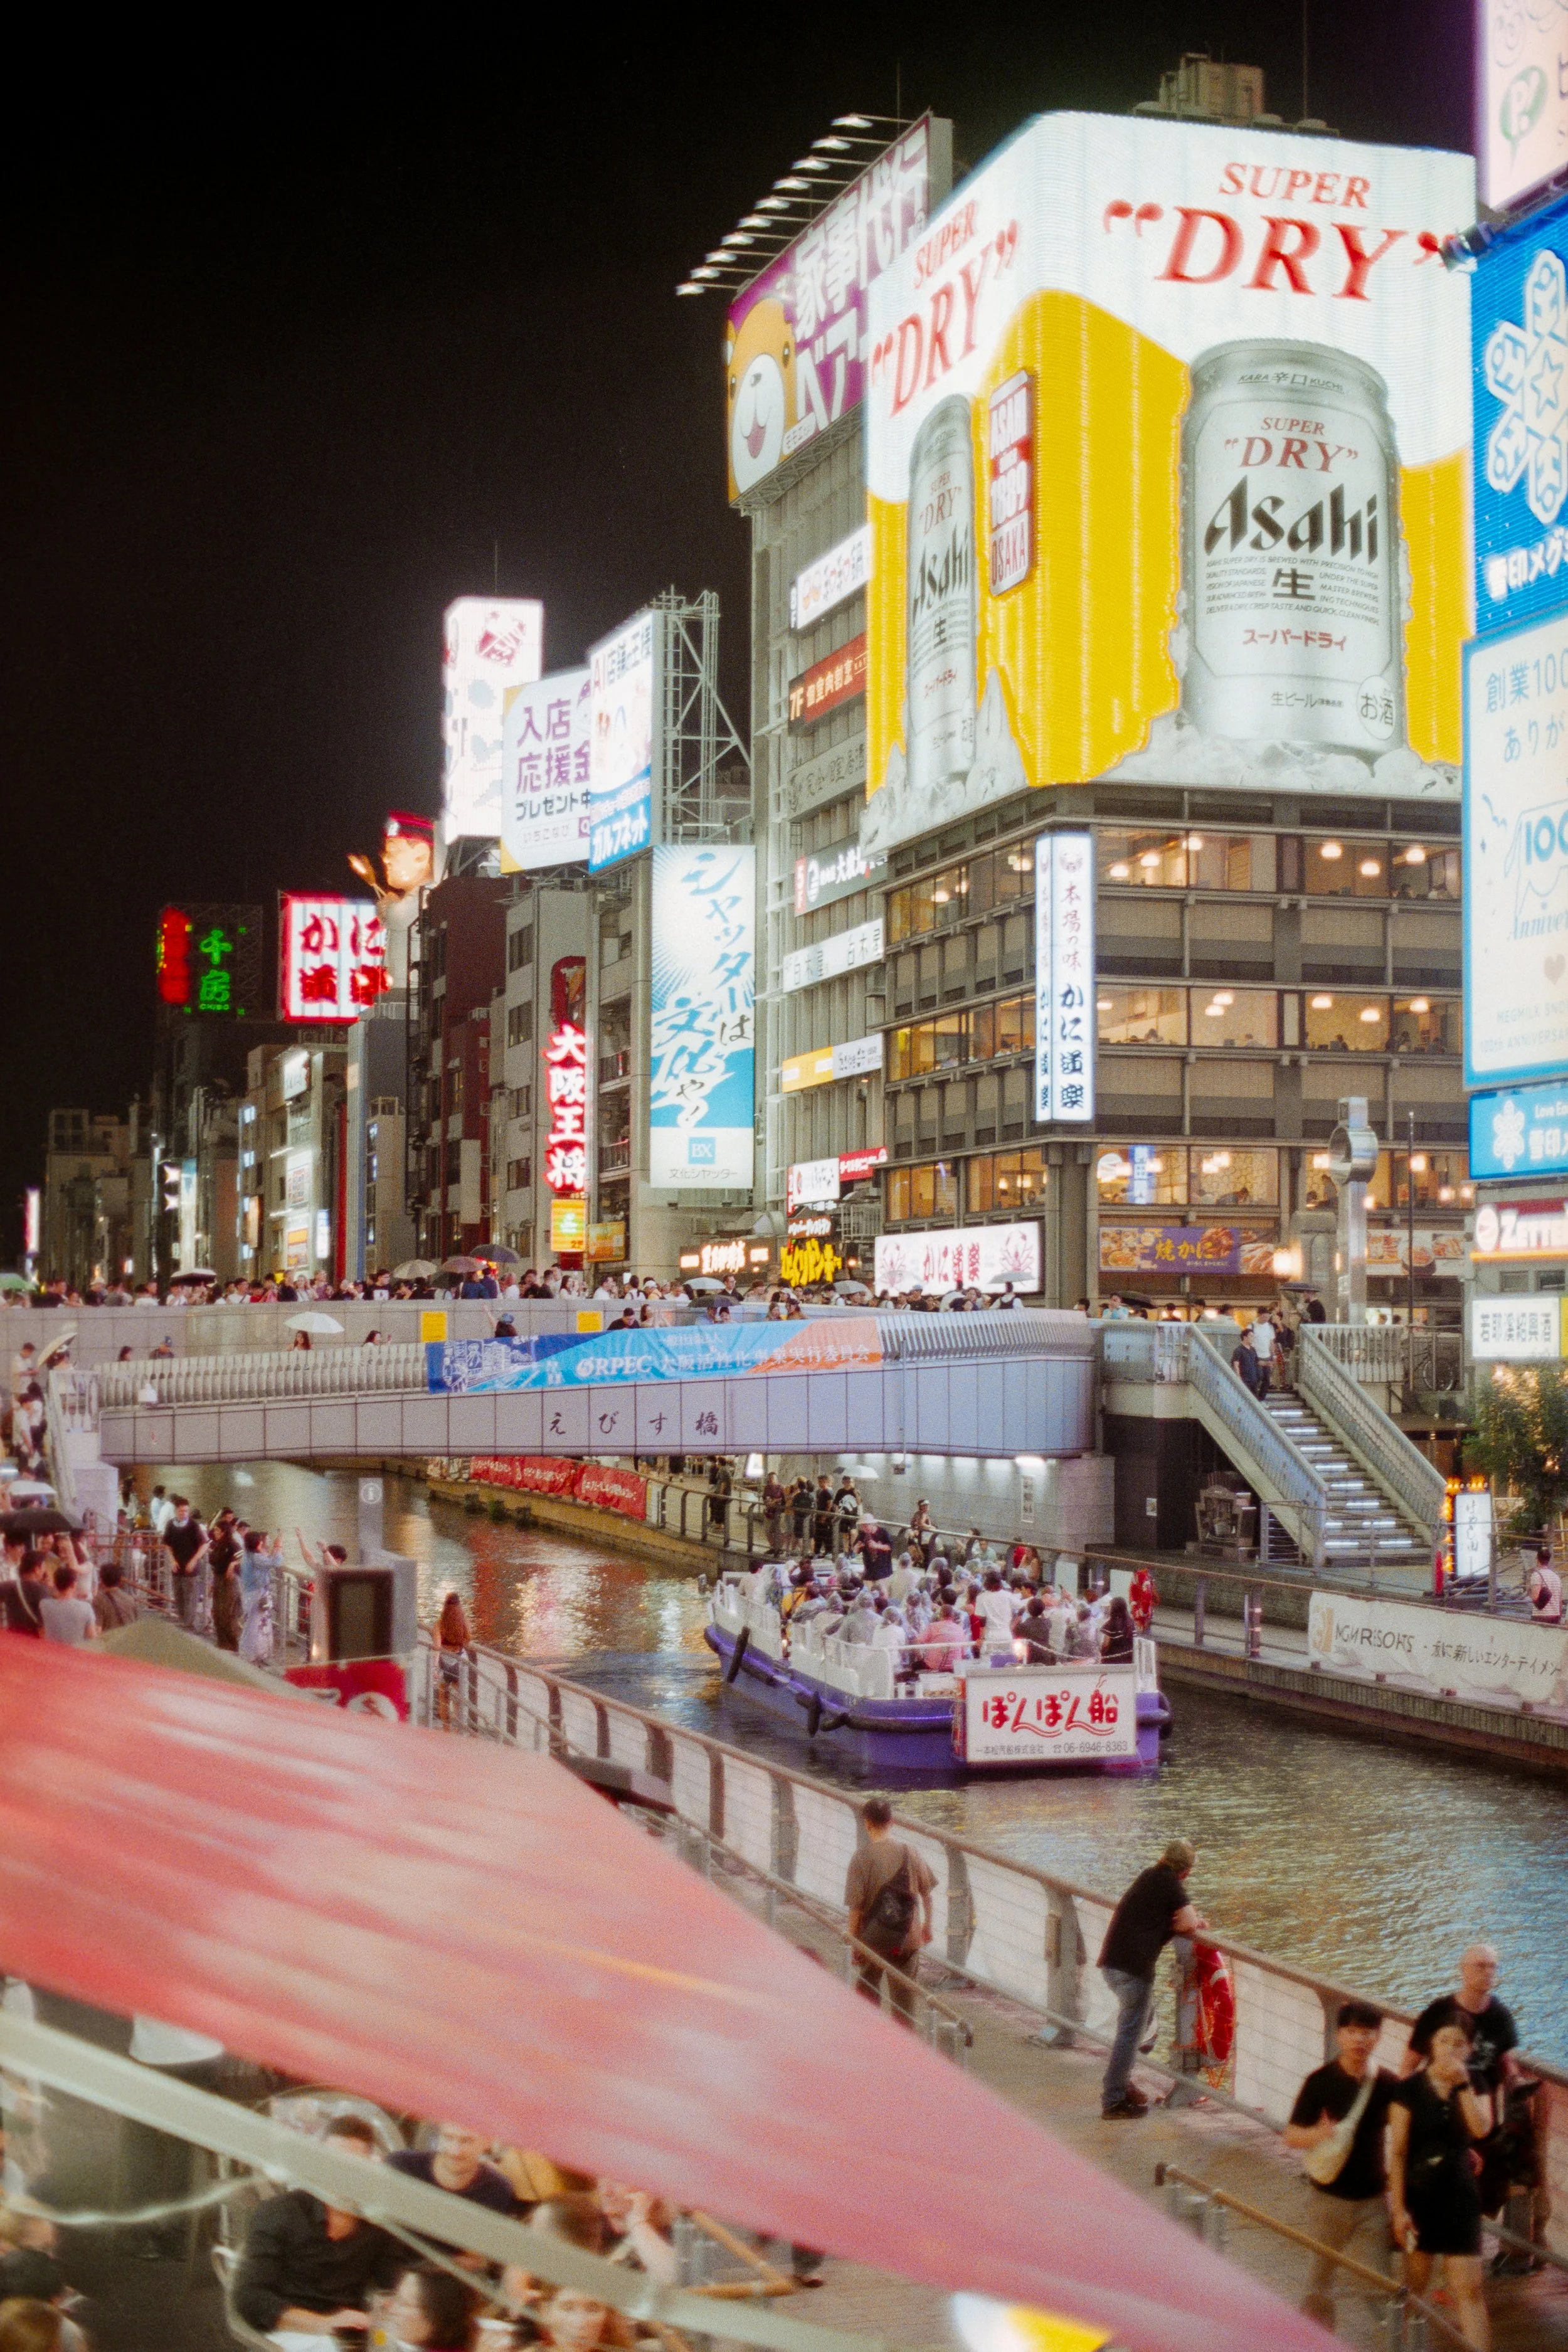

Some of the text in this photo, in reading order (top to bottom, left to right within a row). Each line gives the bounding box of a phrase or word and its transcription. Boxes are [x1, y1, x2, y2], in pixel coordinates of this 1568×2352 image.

[1219, 162, 1370, 209] SUPER
[913, 199, 978, 289] SUPER
[1238, 374, 1269, 383] KARA
[1271, 372, 1307, 386] 辛口
[1261, 416, 1325, 436] SUPER
[930, 470, 951, 493] SUPER
[1204, 475, 1379, 564] Asahi
[992, 521, 1026, 586] OSAKA
[1267, 556, 1298, 564] BREWED
[1300, 558, 1319, 566] WITH
[913, 522, 968, 627] Asahi
[1271, 568, 1316, 600] 生
[1319, 571, 1345, 583] UNDER
[1319, 584, 1350, 595] MASTER
[1271, 603, 1295, 611] TASTE
[1295, 604, 1313, 612] AND
[1242, 628, 1347, 651] スーパードライ
[789, 687, 805, 721] 7F
[1271, 692, 1317, 708] 生ビール
[517, 697, 571, 748] 入店
[1504, 710, 1565, 763] ありが
[516, 739, 590, 795] 応援金
[592, 804, 648, 864] ガルフネット
[298, 913, 385, 957] かに
[1061, 883, 1082, 972] 本場の味
[546, 1024, 587, 1189] 大阪王将
[1535, 1104, 1555, 1118] Love
[691, 1143, 713, 1158] BX
[1155, 1238, 1214, 1261] 焼かに
[575, 1355, 653, 1378] ORPEC
[550, 1412, 719, 1436] えびす橋
[982, 1689, 1119, 1737] ぽんぽん船
